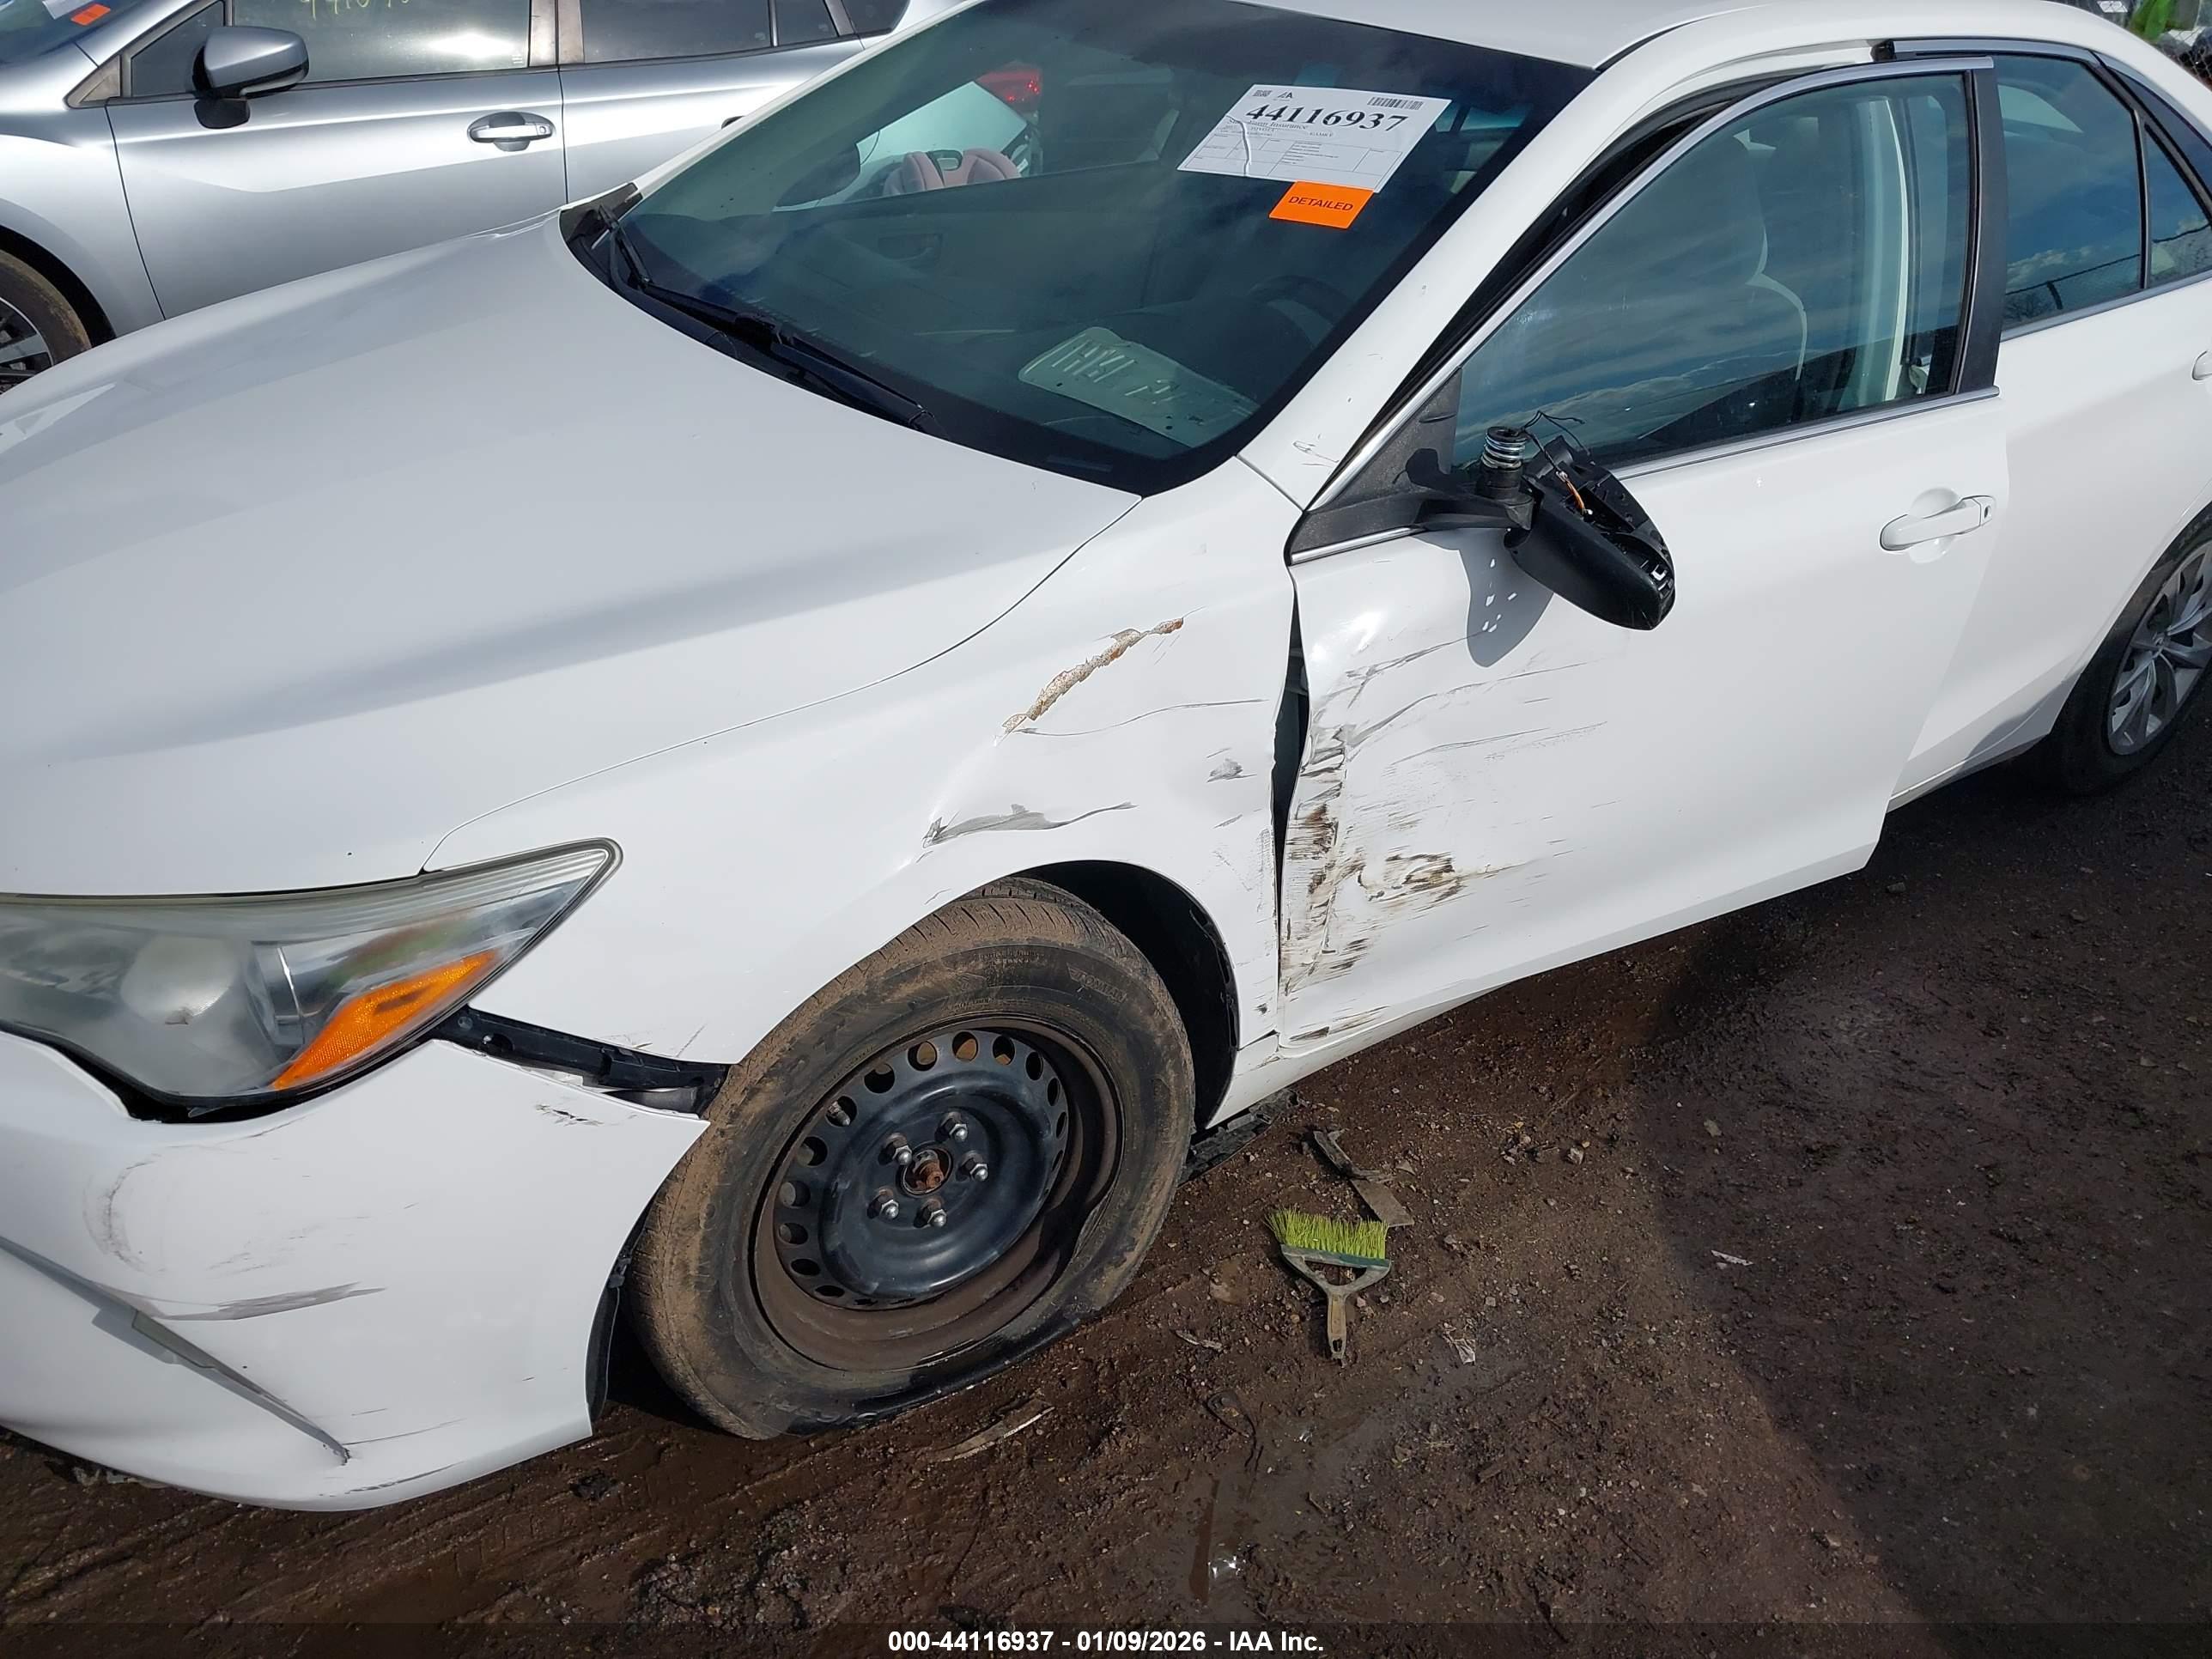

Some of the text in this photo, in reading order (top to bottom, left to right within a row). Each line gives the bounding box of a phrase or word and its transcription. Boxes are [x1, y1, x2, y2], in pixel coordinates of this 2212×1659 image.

[1246, 104, 1408, 131] 44116937
[1269, 121, 1309, 130] Insurance
[1287, 196, 1354, 212] DETAILED
